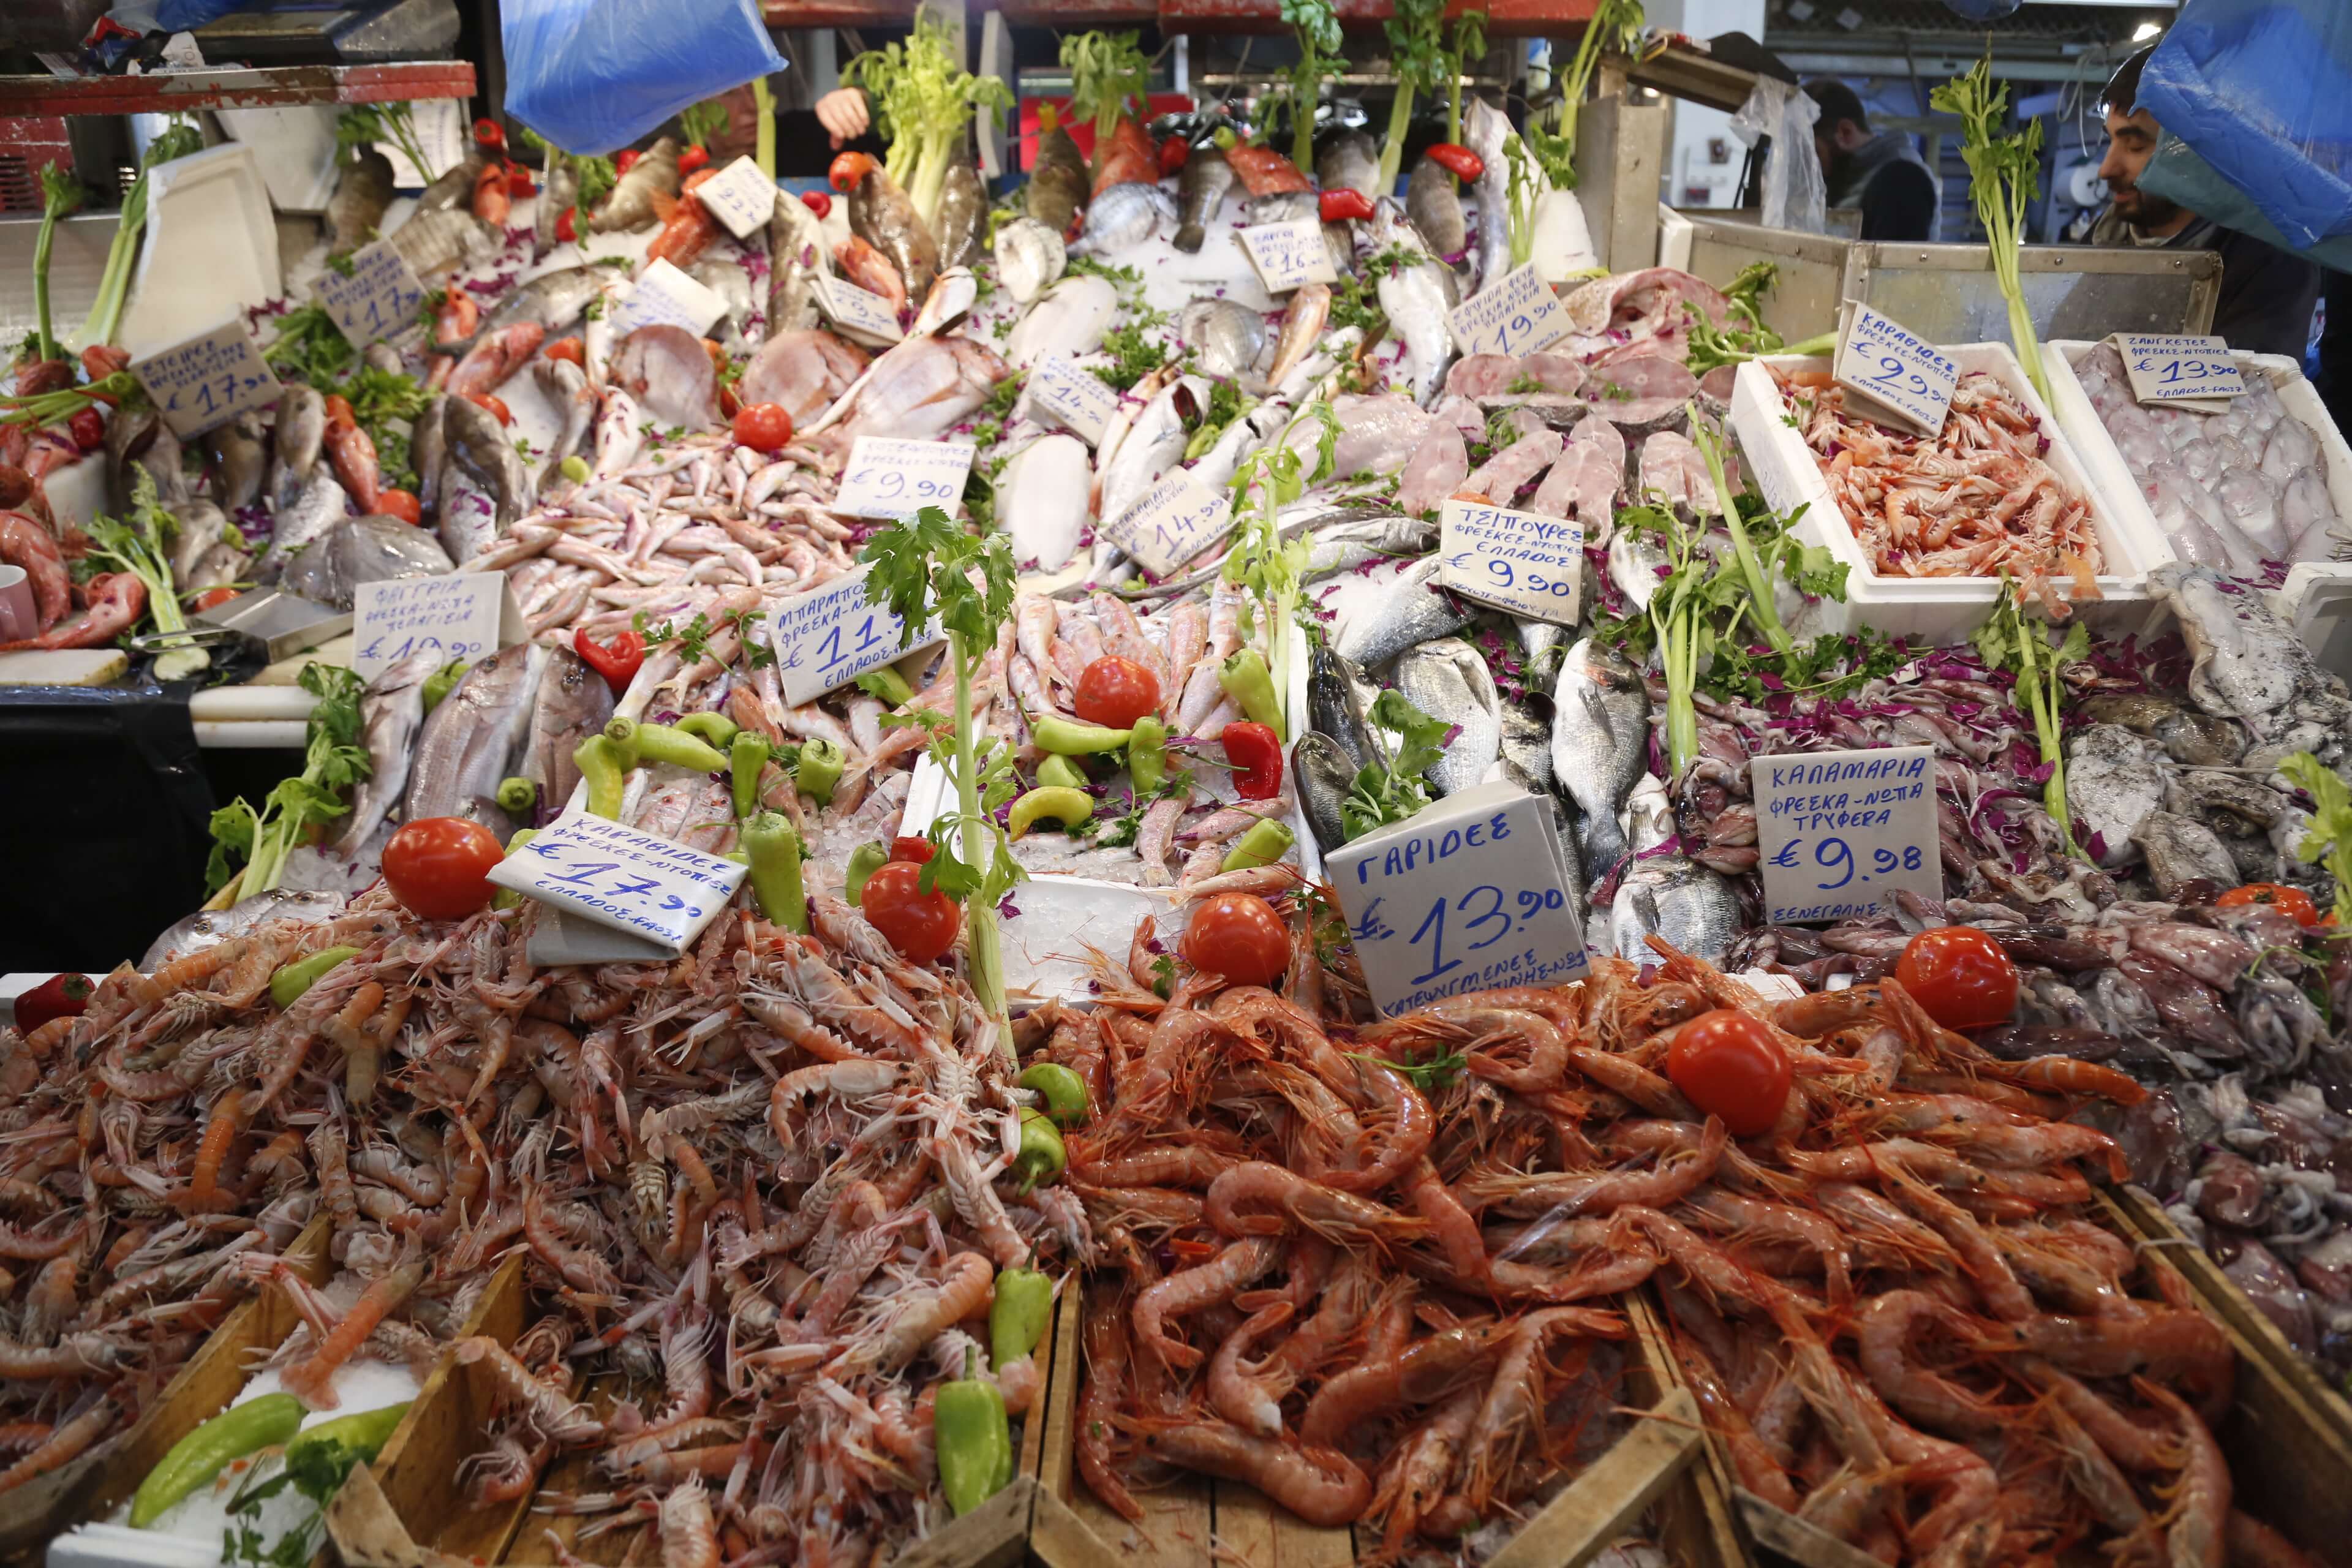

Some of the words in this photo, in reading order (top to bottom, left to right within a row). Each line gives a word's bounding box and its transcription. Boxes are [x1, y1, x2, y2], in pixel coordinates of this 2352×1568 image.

[1493, 301, 1557, 356] 19.90
[1862, 312, 1955, 373] ΚΑΡΑΒΙΔΕΣ
[2128, 337, 2209, 347] ΖΑΝΓΚΕΤΕΣ
[1849, 341, 1875, 359] €
[1871, 357, 1948, 405] 29.90
[2133, 358, 2154, 371] €
[2158, 360, 2237, 384] 13.90
[1048, 386, 1103, 424] 14.90
[846, 469, 875, 484] €
[874, 471, 954, 499] 9.90
[1156, 499, 1224, 560] 14.99
[1460, 509, 1582, 543] ΤΣΙΠΟΥΡΕΣ
[1476, 541, 1569, 567] ΕΛΛΑΔΟΣ
[1443, 552, 1474, 570] €
[1487, 560, 1570, 597] 9.90
[358, 636, 385, 658] €
[780, 644, 804, 669] €
[1773, 757, 1926, 788] ΚΑΛΑΜΑΡΙΑ
[1793, 809, 1892, 831] ΤΡΥΦΕΡΑ
[524, 840, 579, 860] €
[571, 818, 731, 874] ΚΑΡΑΒΙΔΕΣ
[1357, 812, 1512, 884] ΓΑΡΙΔΕΣ
[1768, 839, 1804, 867] €
[1815, 837, 1922, 890] 9.98
[543, 862, 703, 918] 17.90
[1349, 896, 1396, 941] €
[1409, 886, 1563, 986] 13.90
